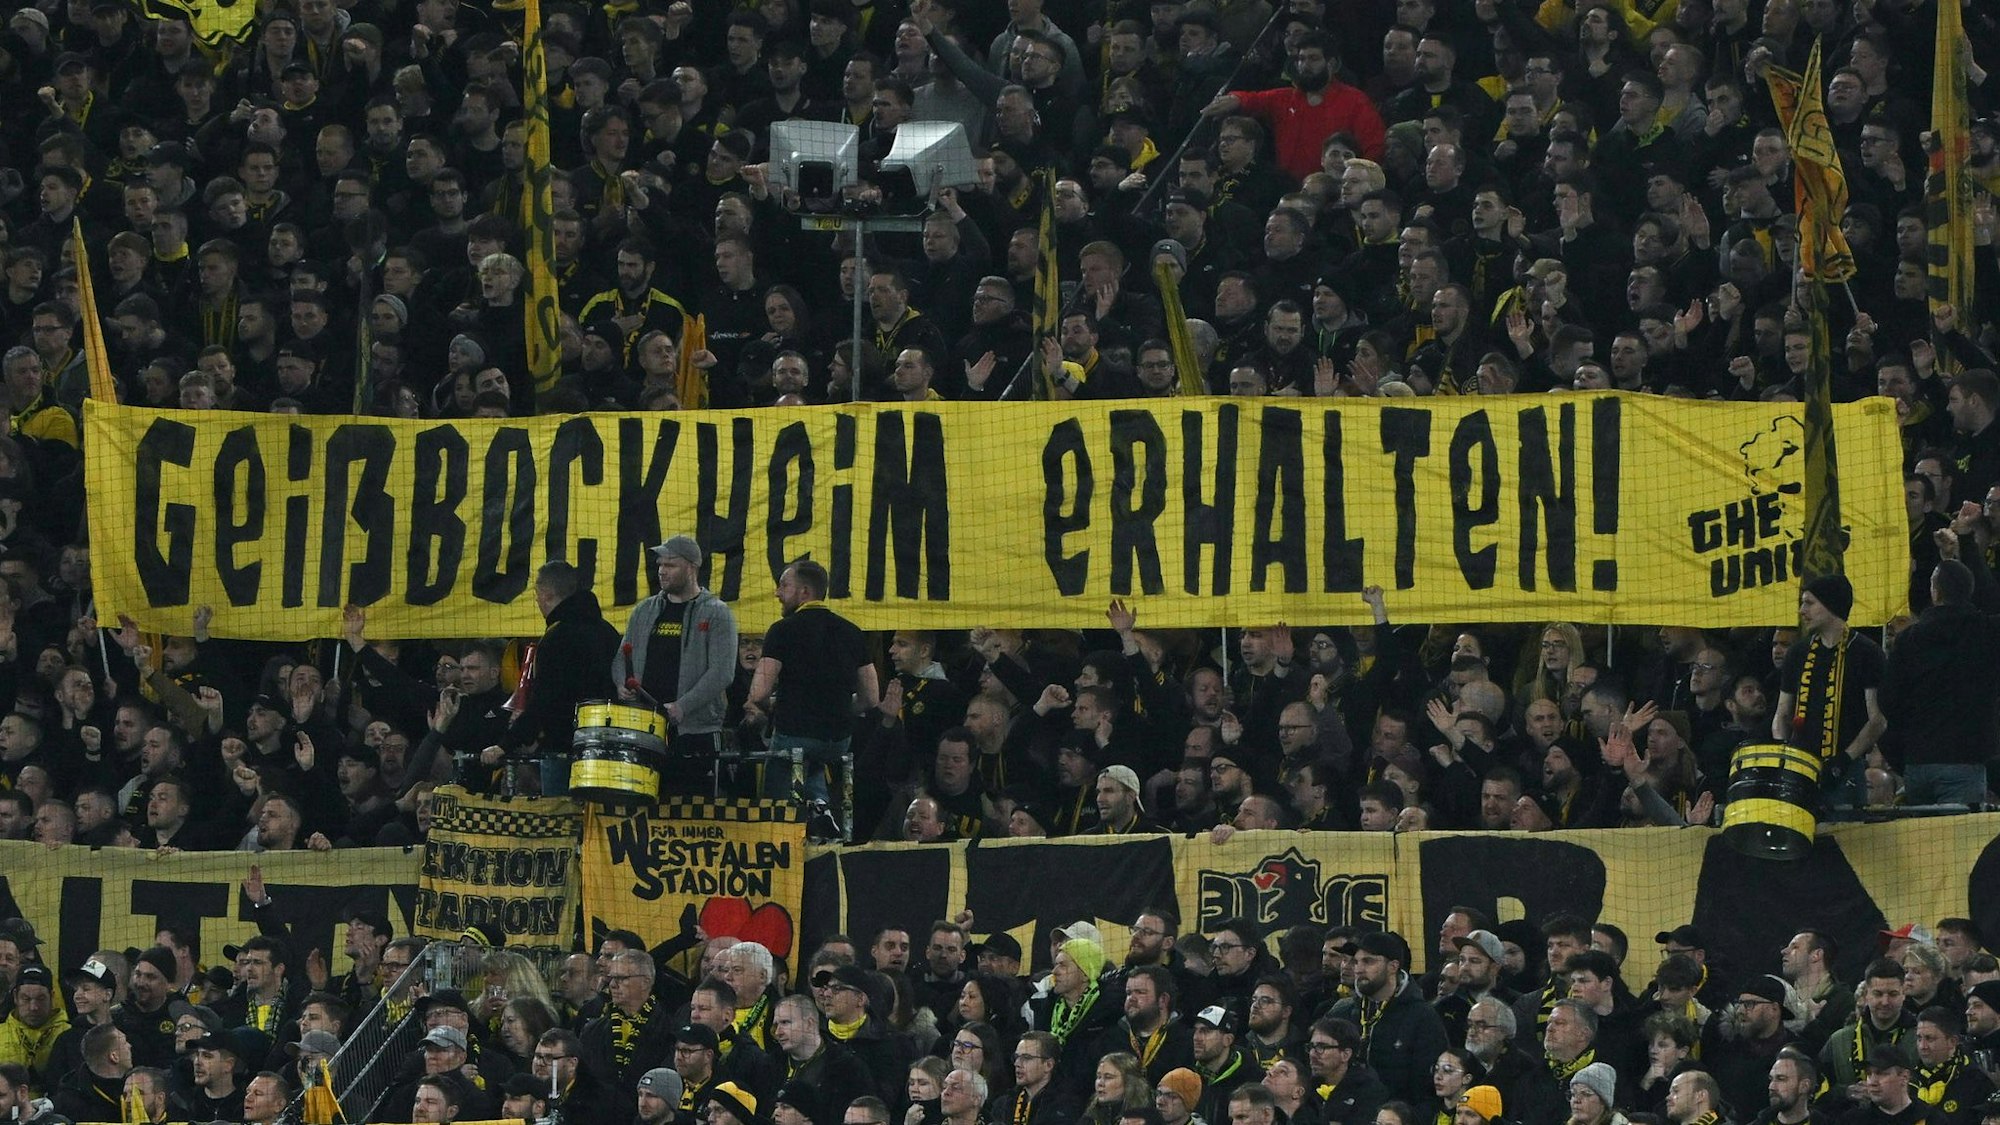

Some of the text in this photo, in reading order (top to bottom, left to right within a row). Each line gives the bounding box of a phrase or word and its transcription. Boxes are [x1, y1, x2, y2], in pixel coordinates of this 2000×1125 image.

[606, 811, 790, 869] WESTFALEN
[650, 824, 725, 839] FÜR IMMER
[631, 865, 772, 901] STADION
